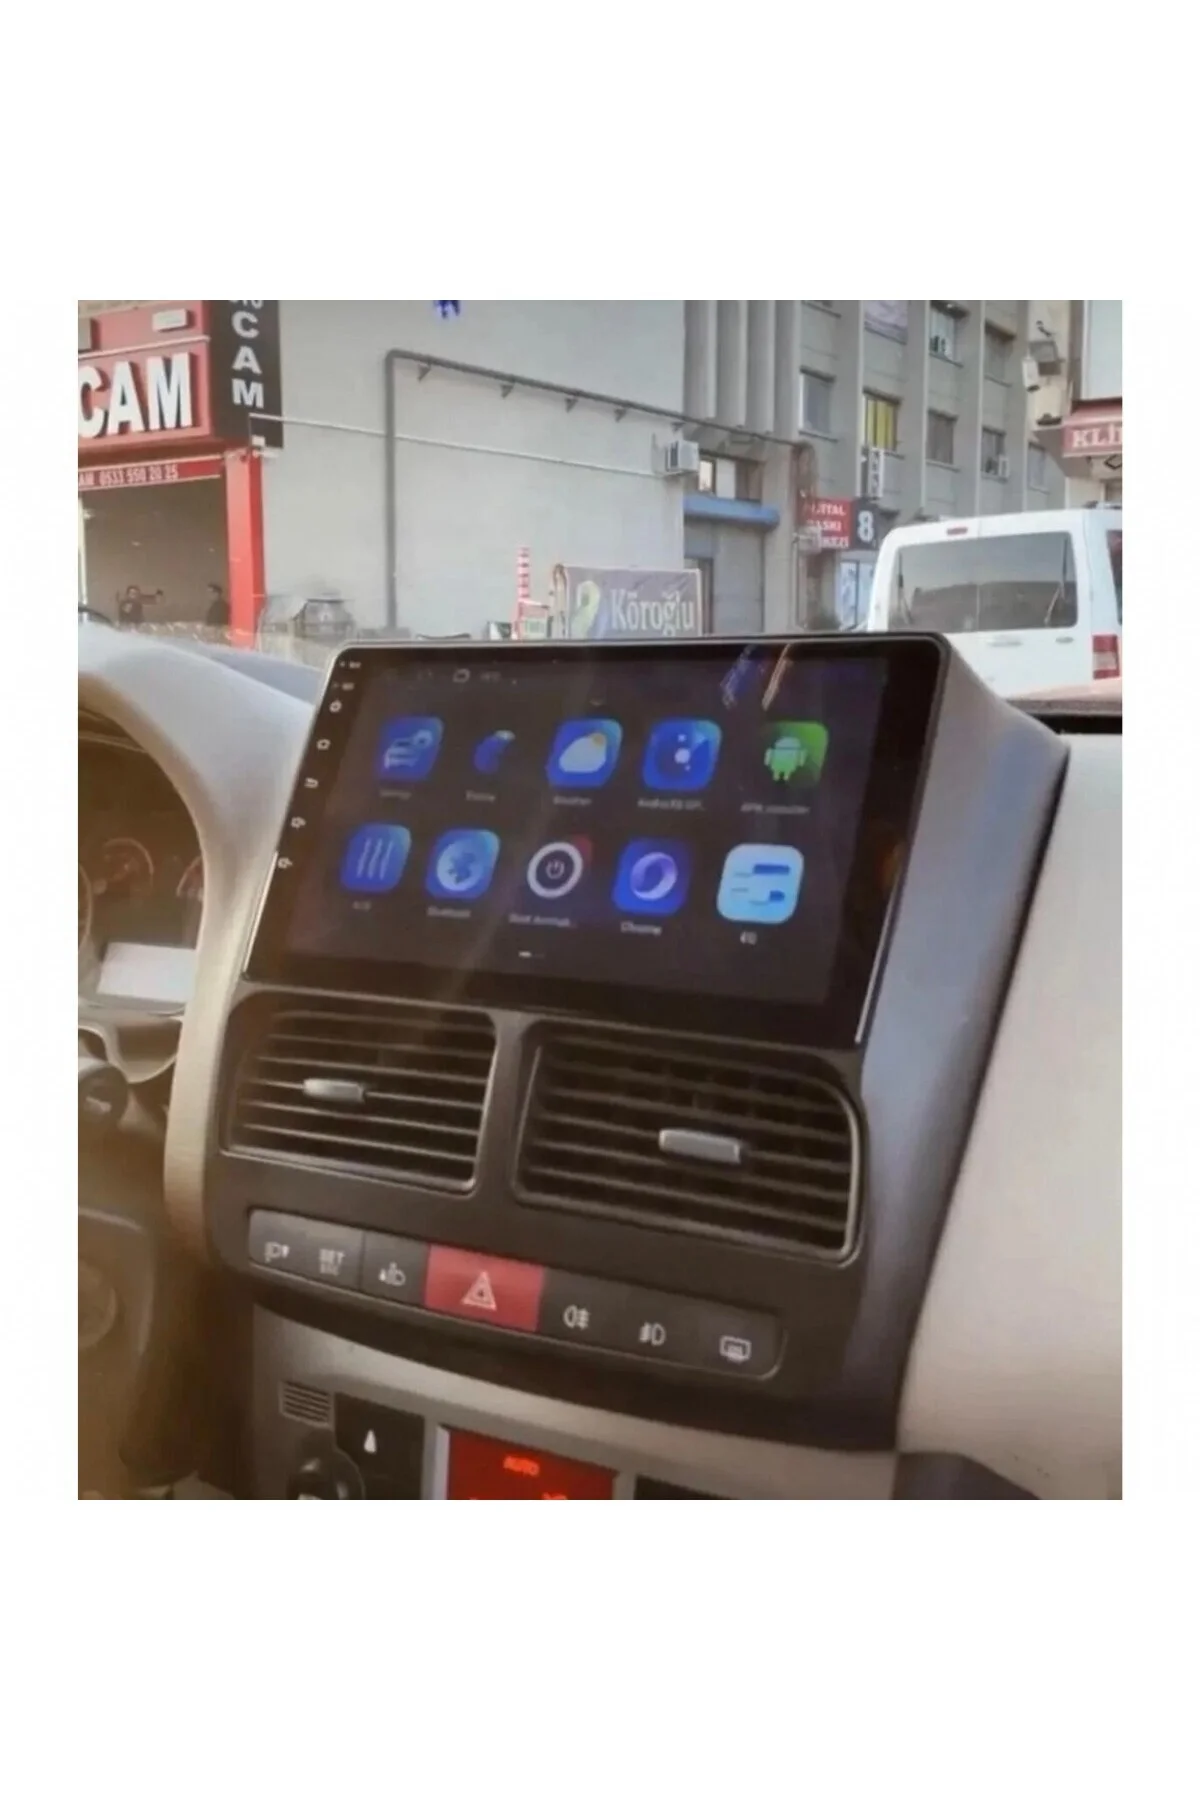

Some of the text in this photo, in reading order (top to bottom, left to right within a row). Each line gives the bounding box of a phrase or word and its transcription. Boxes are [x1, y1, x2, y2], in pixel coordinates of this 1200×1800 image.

[78, 352, 192, 438] CAM
[232, 311, 264, 409] CAM
[611, 588, 695, 637] Köroğlu
